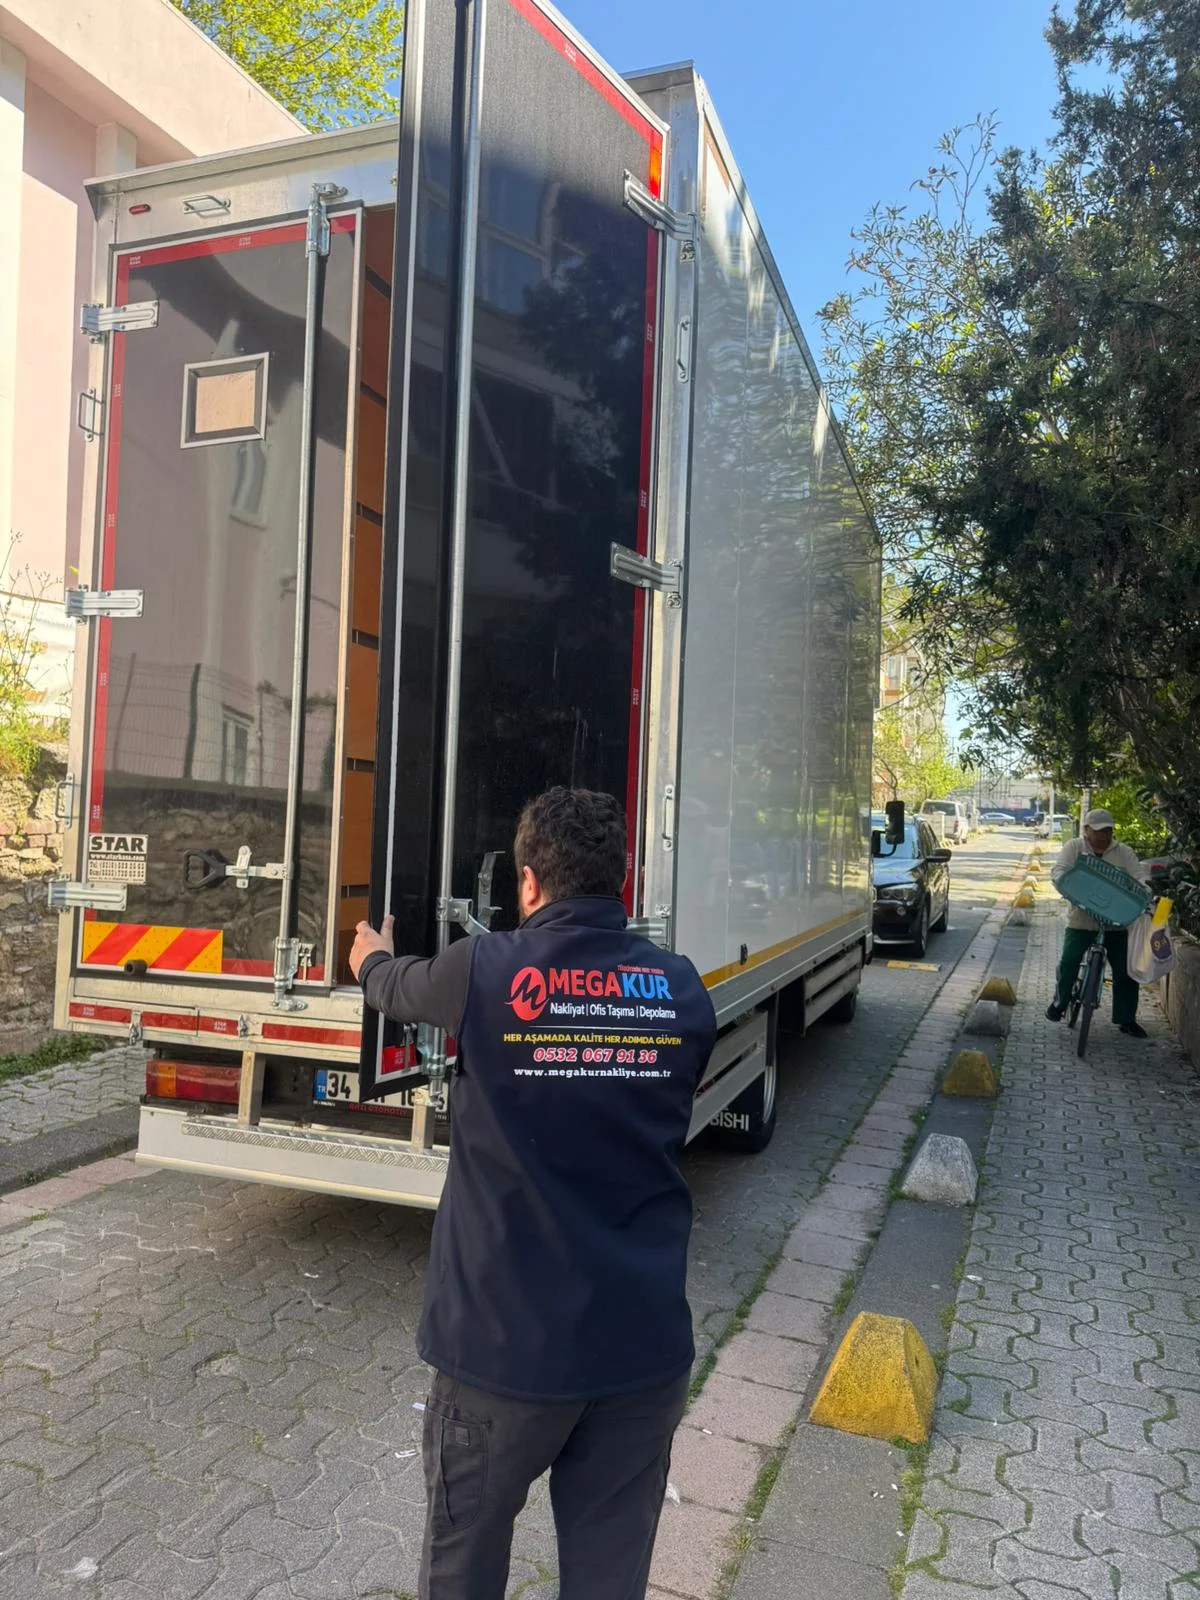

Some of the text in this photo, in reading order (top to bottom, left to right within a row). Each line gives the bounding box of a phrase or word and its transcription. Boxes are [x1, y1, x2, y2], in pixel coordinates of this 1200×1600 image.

[91, 836, 144, 852] STAR
[549, 968, 673, 1000] MEGAKUR
[550, 1002, 676, 1020] Nakliyat Ofis Taşıma Depolama
[503, 1033, 681, 1045] HER AŞAMADA KALİTE HER ADIMDA GÜVEN
[533, 1048, 658, 1064] 0532 067 91 36
[513, 1067, 671, 1078] www.megakurnakliye.com.tr
[317, 1073, 351, 1099] TR 34
